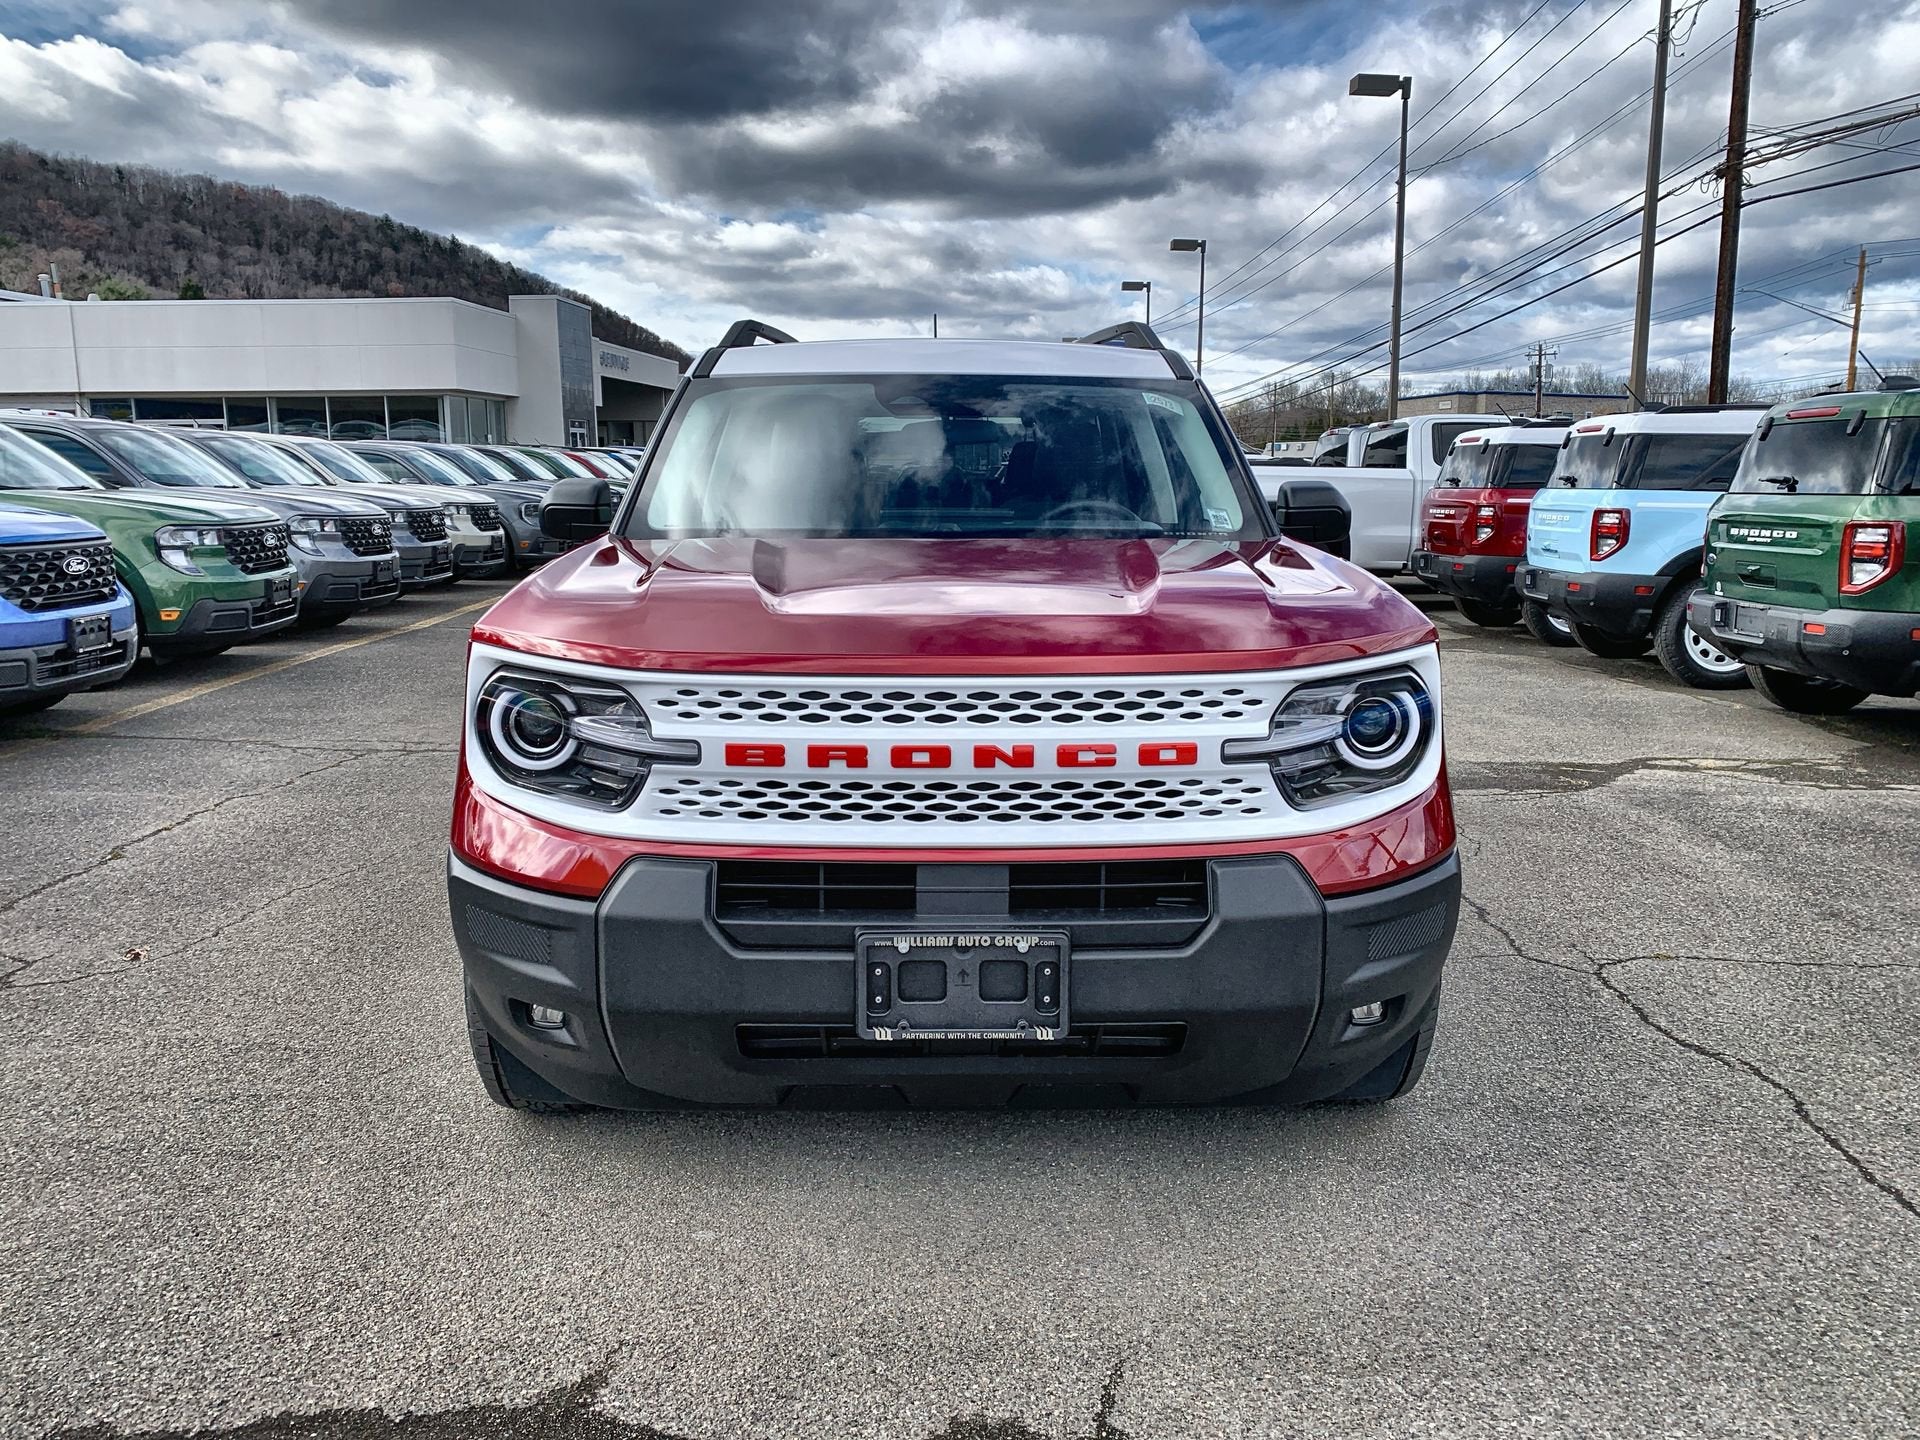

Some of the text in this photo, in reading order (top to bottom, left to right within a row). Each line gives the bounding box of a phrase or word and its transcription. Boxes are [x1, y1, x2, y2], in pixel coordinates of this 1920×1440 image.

[1730, 527, 1798, 539] BRONCO
[66, 558, 88, 573] Ford
[724, 742, 1198, 769] BRONCO
[957, 935, 992, 947] AUTO
[901, 1032, 1026, 1040] PARTNERING WITH THE COMMUNITY
